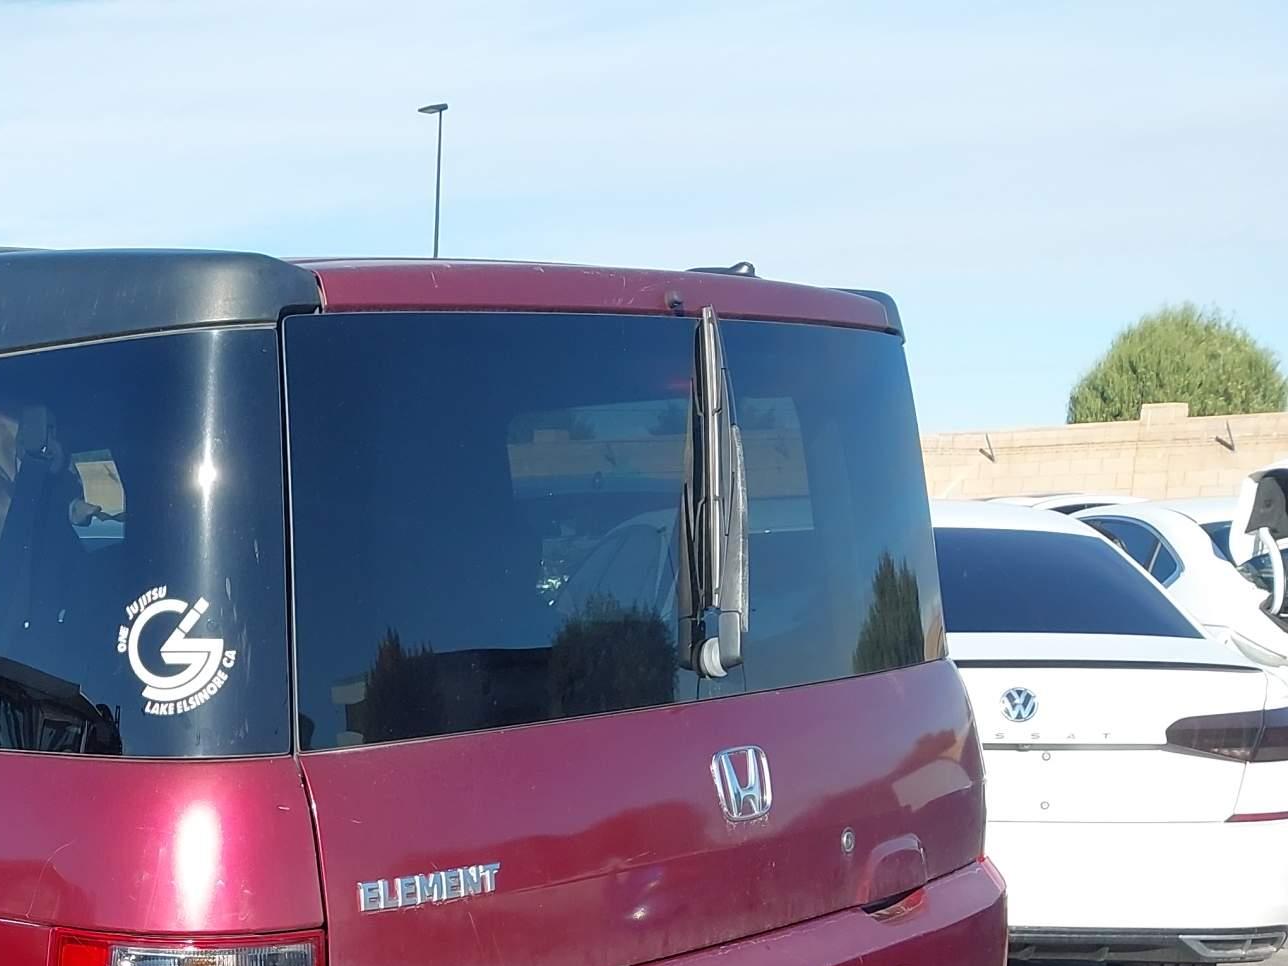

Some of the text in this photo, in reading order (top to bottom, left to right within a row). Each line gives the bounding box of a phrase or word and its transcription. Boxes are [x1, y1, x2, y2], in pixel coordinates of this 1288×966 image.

[117, 625, 129, 653] ONE
[144, 650, 237, 716] LAKE ELSINORE CA
[995, 732, 1111, 740] SSAT
[357, 862, 501, 912] ELEMENT
